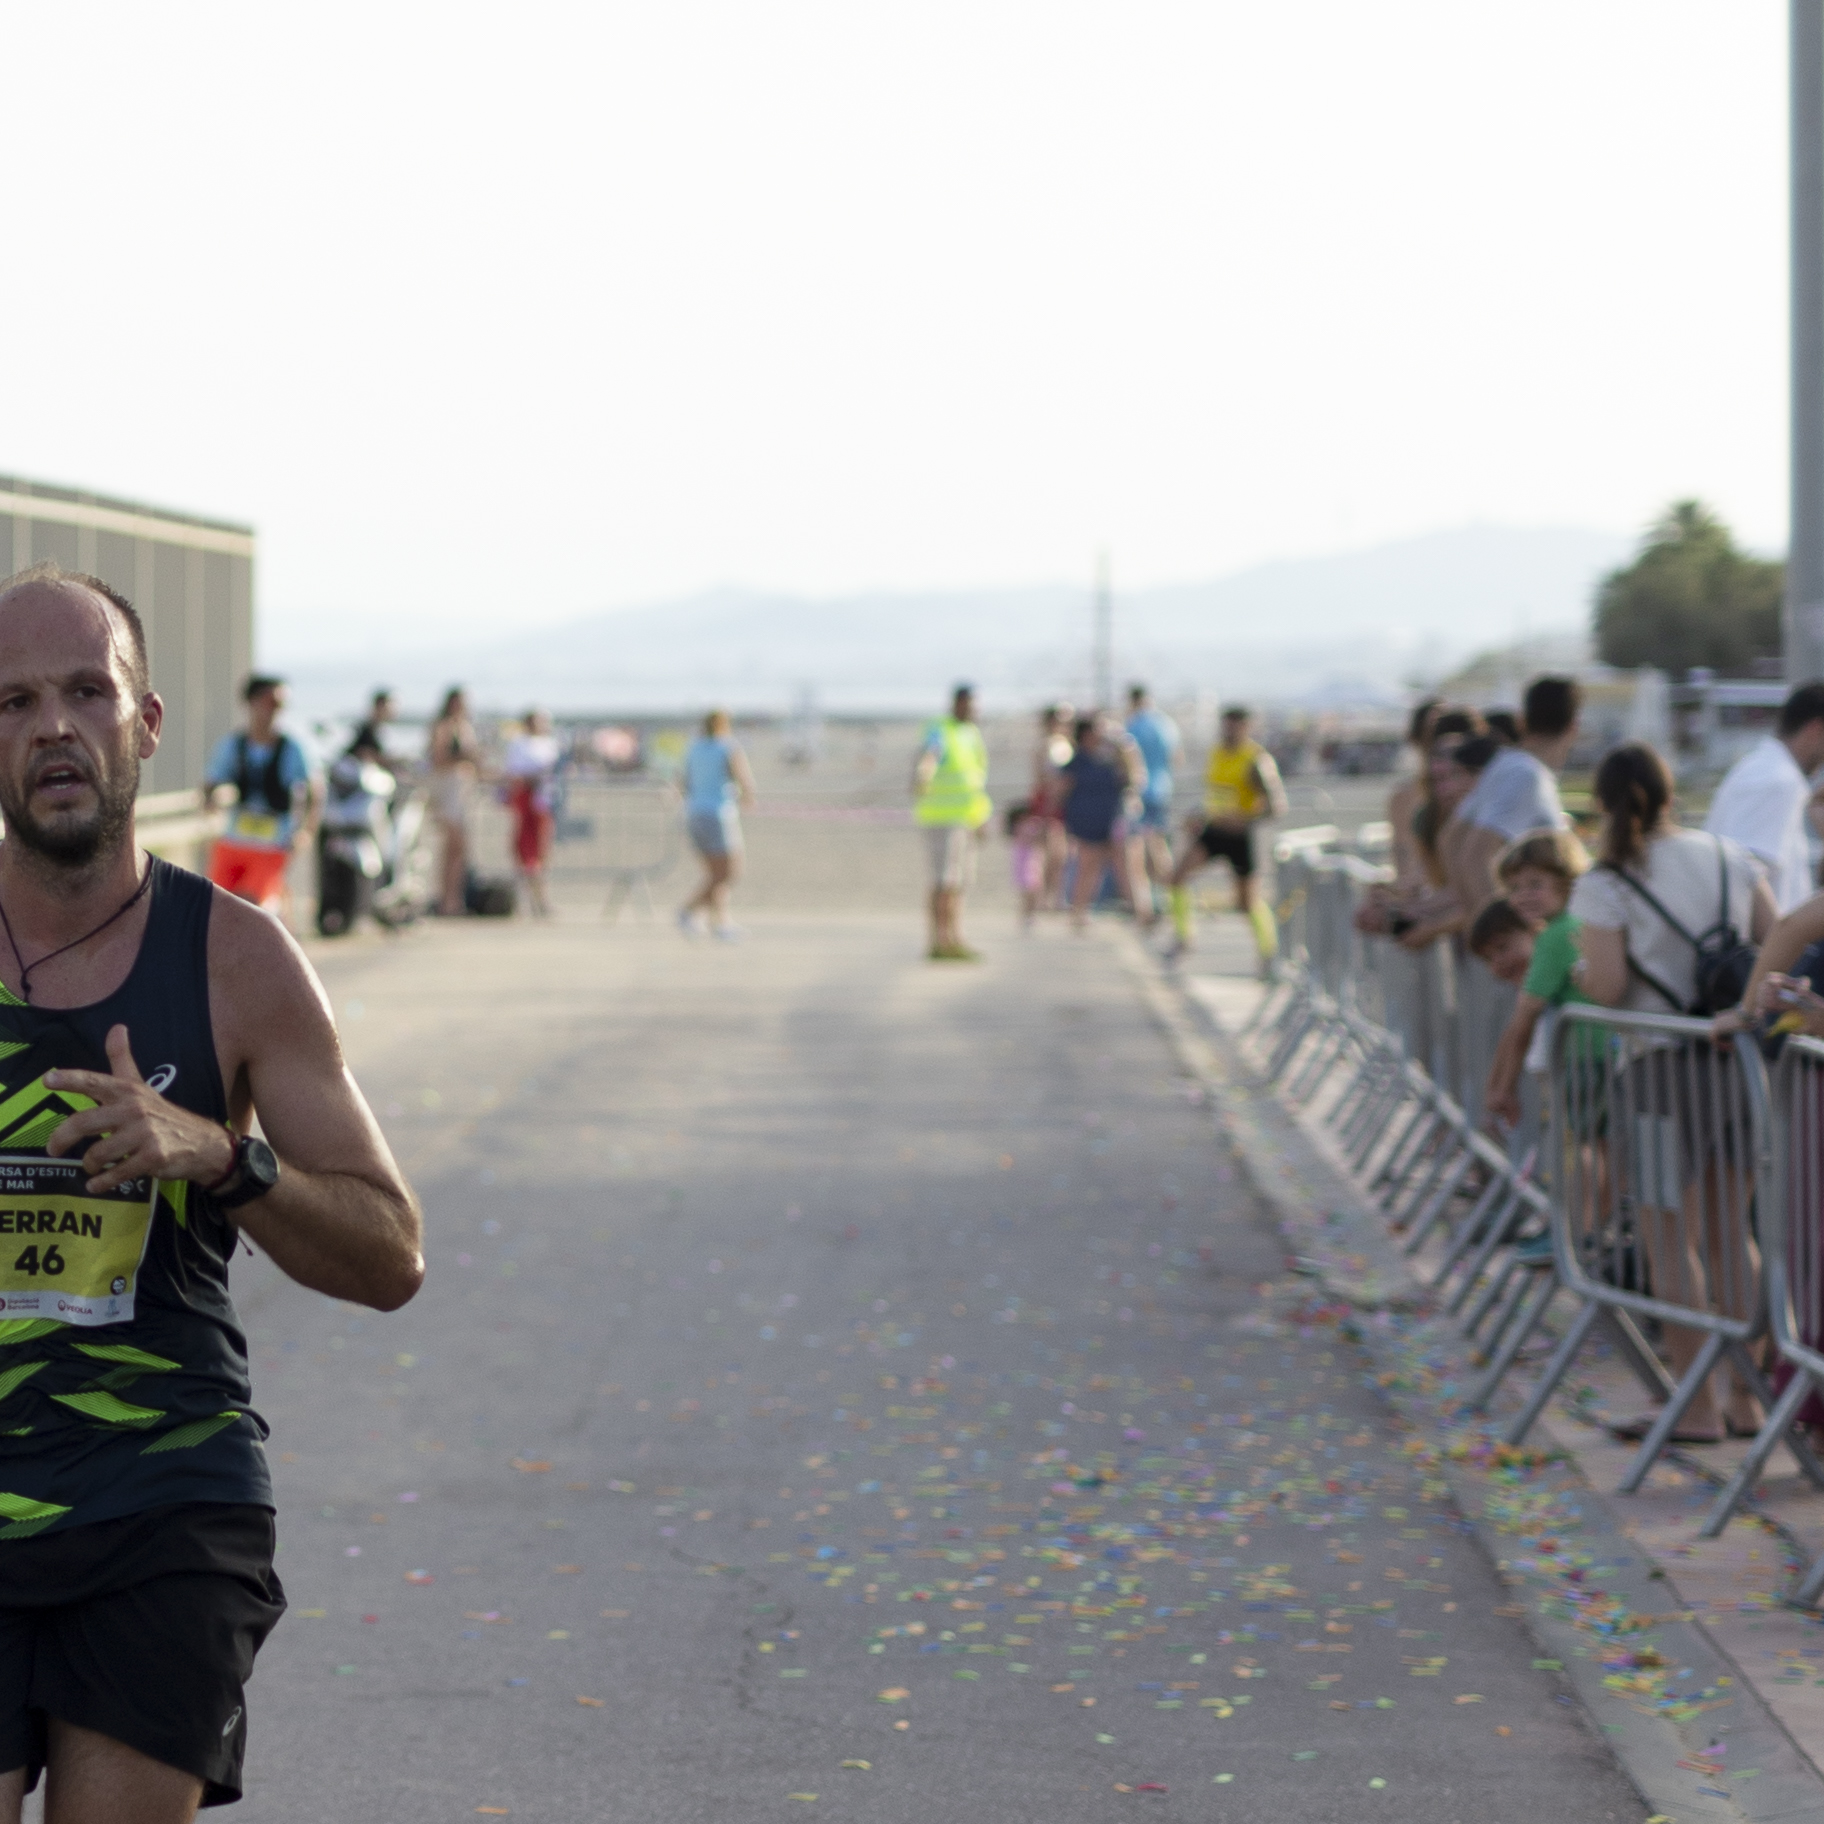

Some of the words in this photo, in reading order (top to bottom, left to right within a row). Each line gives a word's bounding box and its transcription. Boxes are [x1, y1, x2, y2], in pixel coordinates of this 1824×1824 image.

[26, 1166, 77, 1177] D'ESTIU
[6, 1179, 34, 1190] MAR
[14, 1243, 65, 1276] 46
